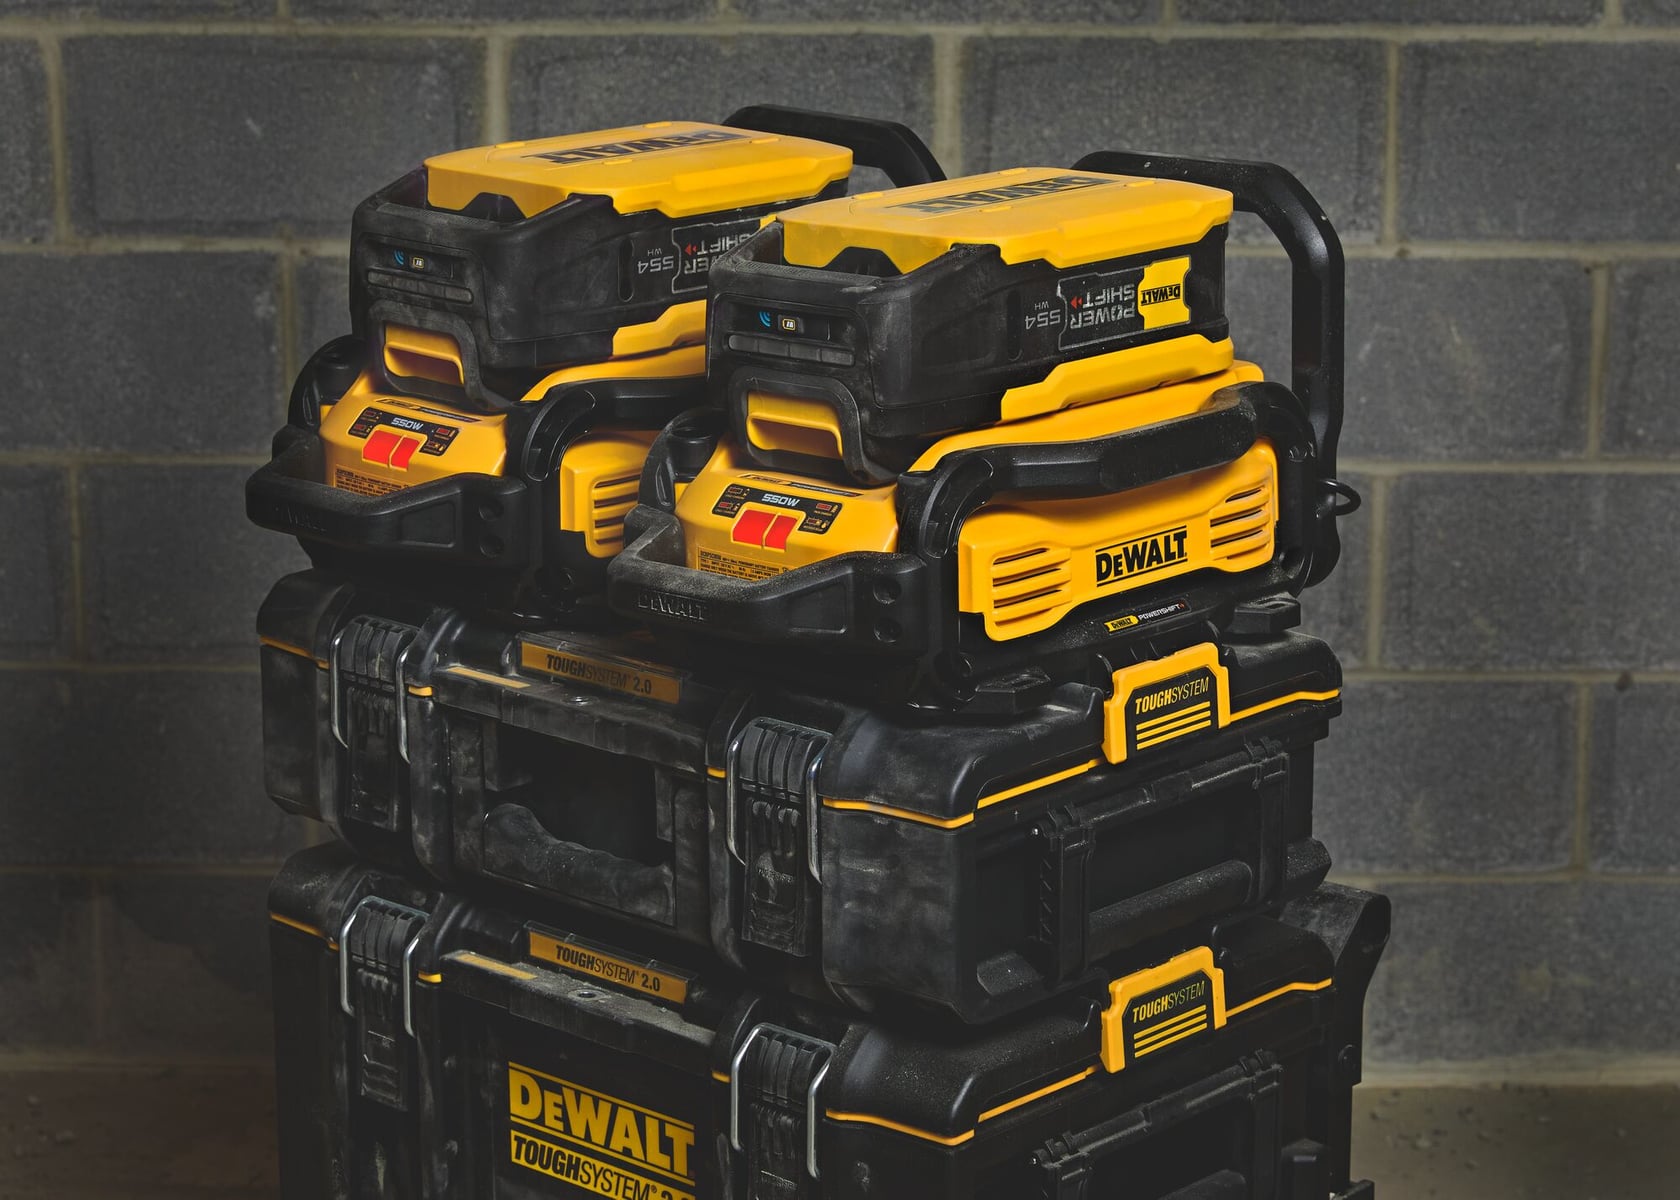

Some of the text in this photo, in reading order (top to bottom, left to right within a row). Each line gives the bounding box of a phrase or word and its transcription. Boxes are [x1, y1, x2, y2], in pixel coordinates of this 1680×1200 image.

[647, 248, 662, 257] WH
[638, 255, 674, 275] 554
[1034, 302, 1050, 310] WH
[1082, 284, 1136, 309] SHIFT
[1024, 309, 1062, 331] 554
[1070, 303, 1136, 329] POWER
[633, 676, 652, 695] 2.0
[1135, 676, 1210, 715] TOUGHSYSTEM
[641, 973, 661, 992] 2.0
[1132, 980, 1206, 1024] TOUGHSYSTEM
